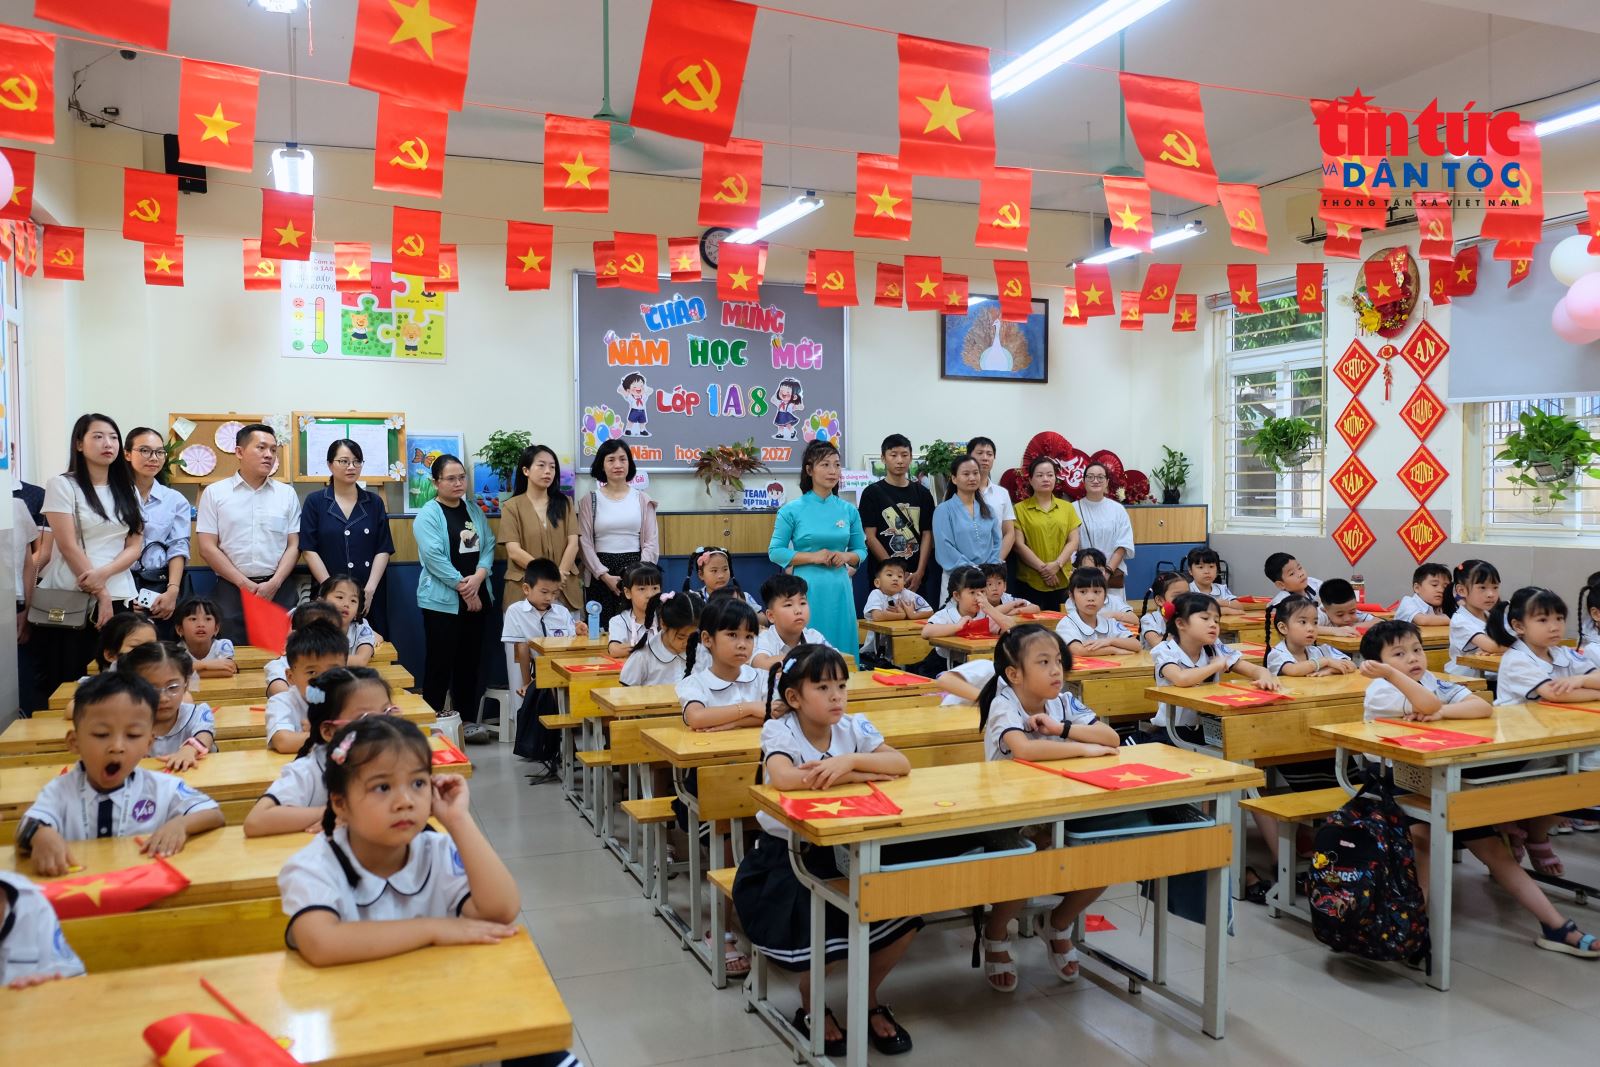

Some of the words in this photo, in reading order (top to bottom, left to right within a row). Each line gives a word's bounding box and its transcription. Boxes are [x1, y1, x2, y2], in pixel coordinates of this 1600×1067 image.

[608, 333, 670, 366] NĂM
[689, 338, 747, 371] HỌC
[772, 337, 822, 370] MỚI
[1414, 337, 1435, 363] AN
[1343, 353, 1367, 380] CHÚC
[1411, 397, 1433, 425] KHANG
[630, 445, 662, 460] Năm
[675, 445, 702, 464] học
[761, 447, 792, 461] 2027
[745, 489, 767, 498] TEAM
[1341, 465, 1364, 495] NĂM
[1343, 524, 1363, 551] MỚI
